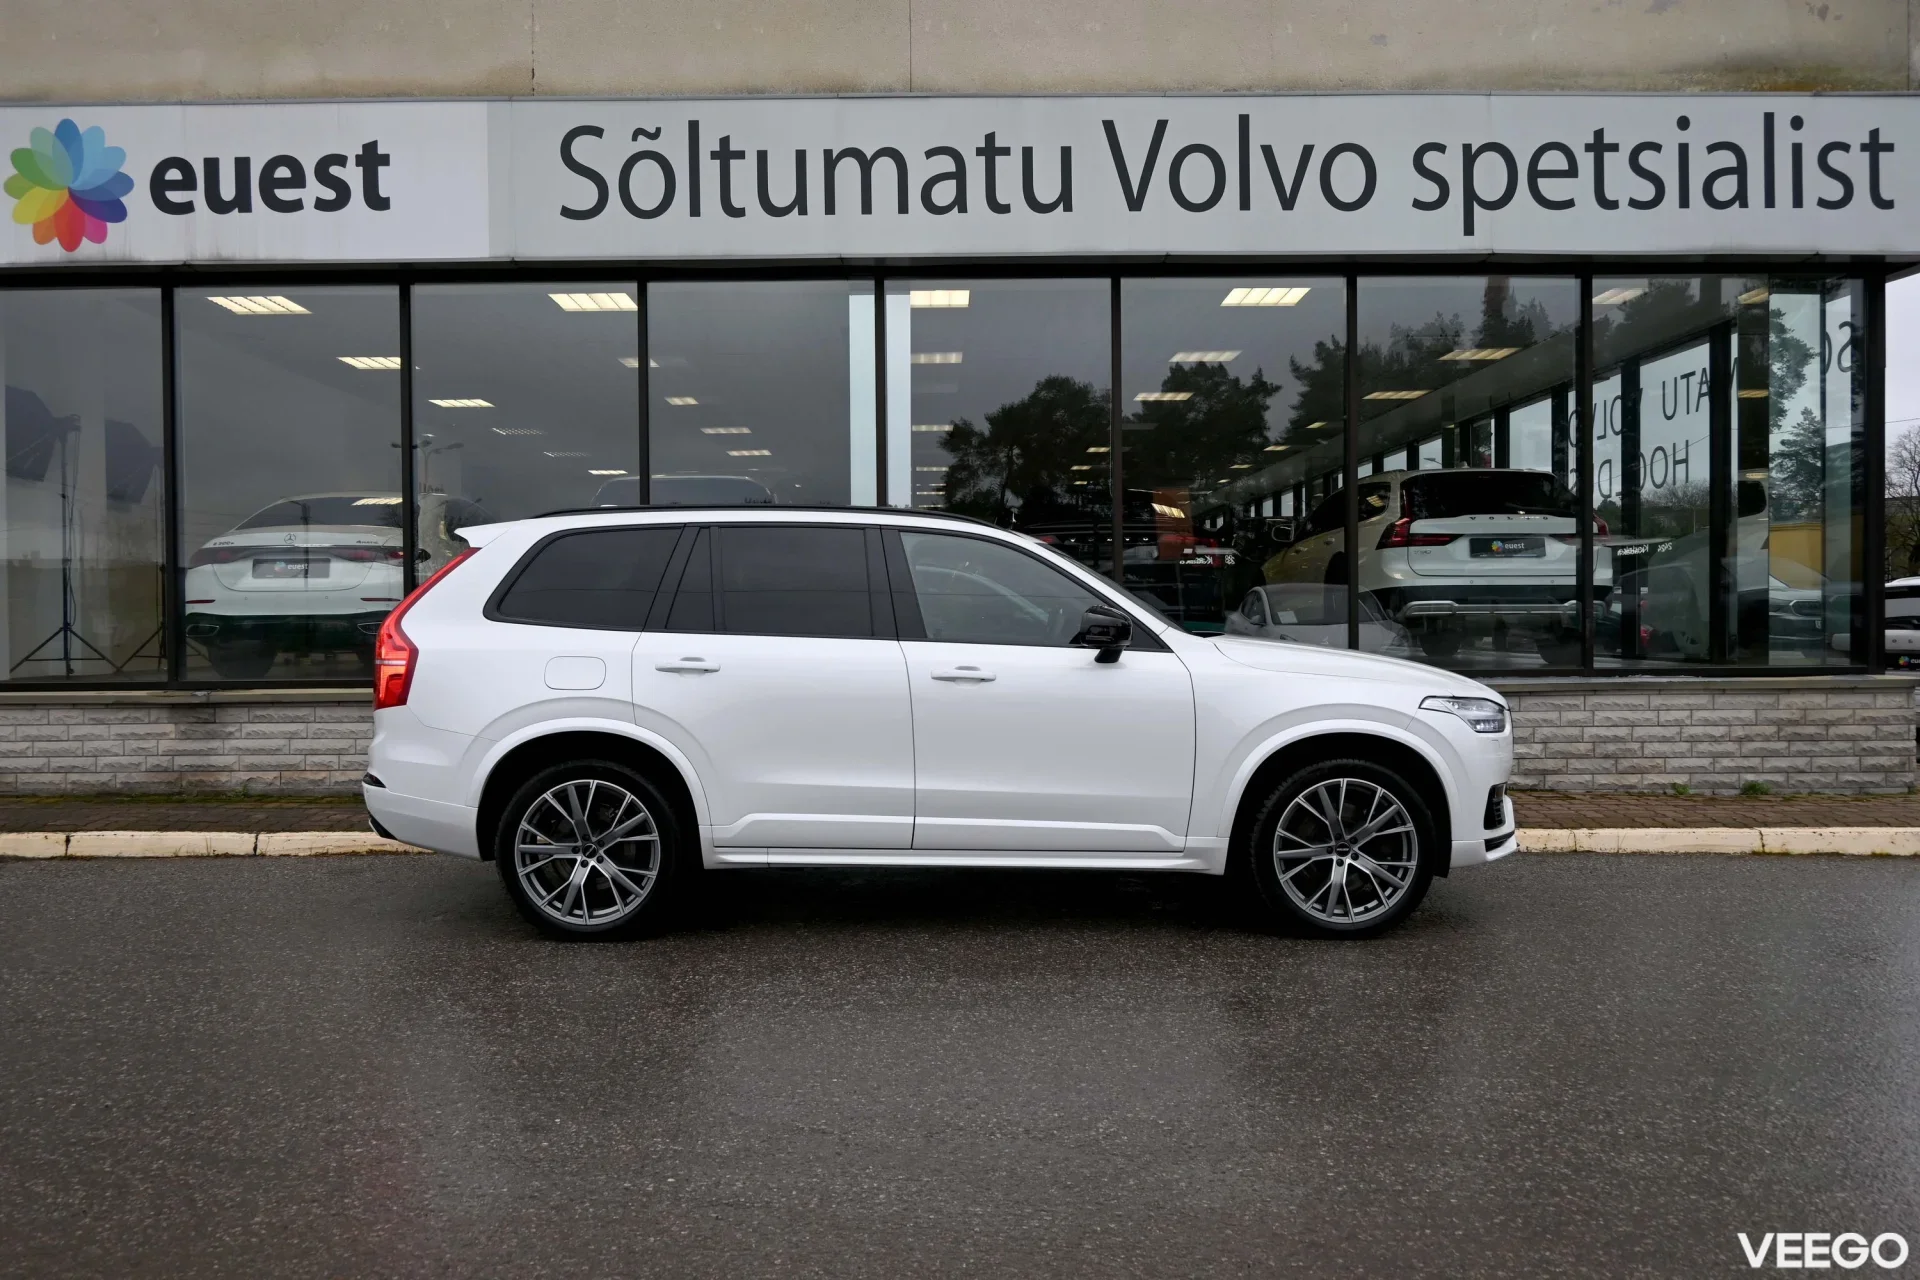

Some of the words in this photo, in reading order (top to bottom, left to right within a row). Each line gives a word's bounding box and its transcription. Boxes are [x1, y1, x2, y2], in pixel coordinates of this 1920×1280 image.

[149, 139, 391, 216] euest
[559, 119, 1074, 221] Sõltumatu
[1101, 113, 1378, 213] Volvo
[1411, 111, 1895, 237] spetsialist
[287, 562, 309, 570] euest
[1504, 542, 1525, 550] euest
